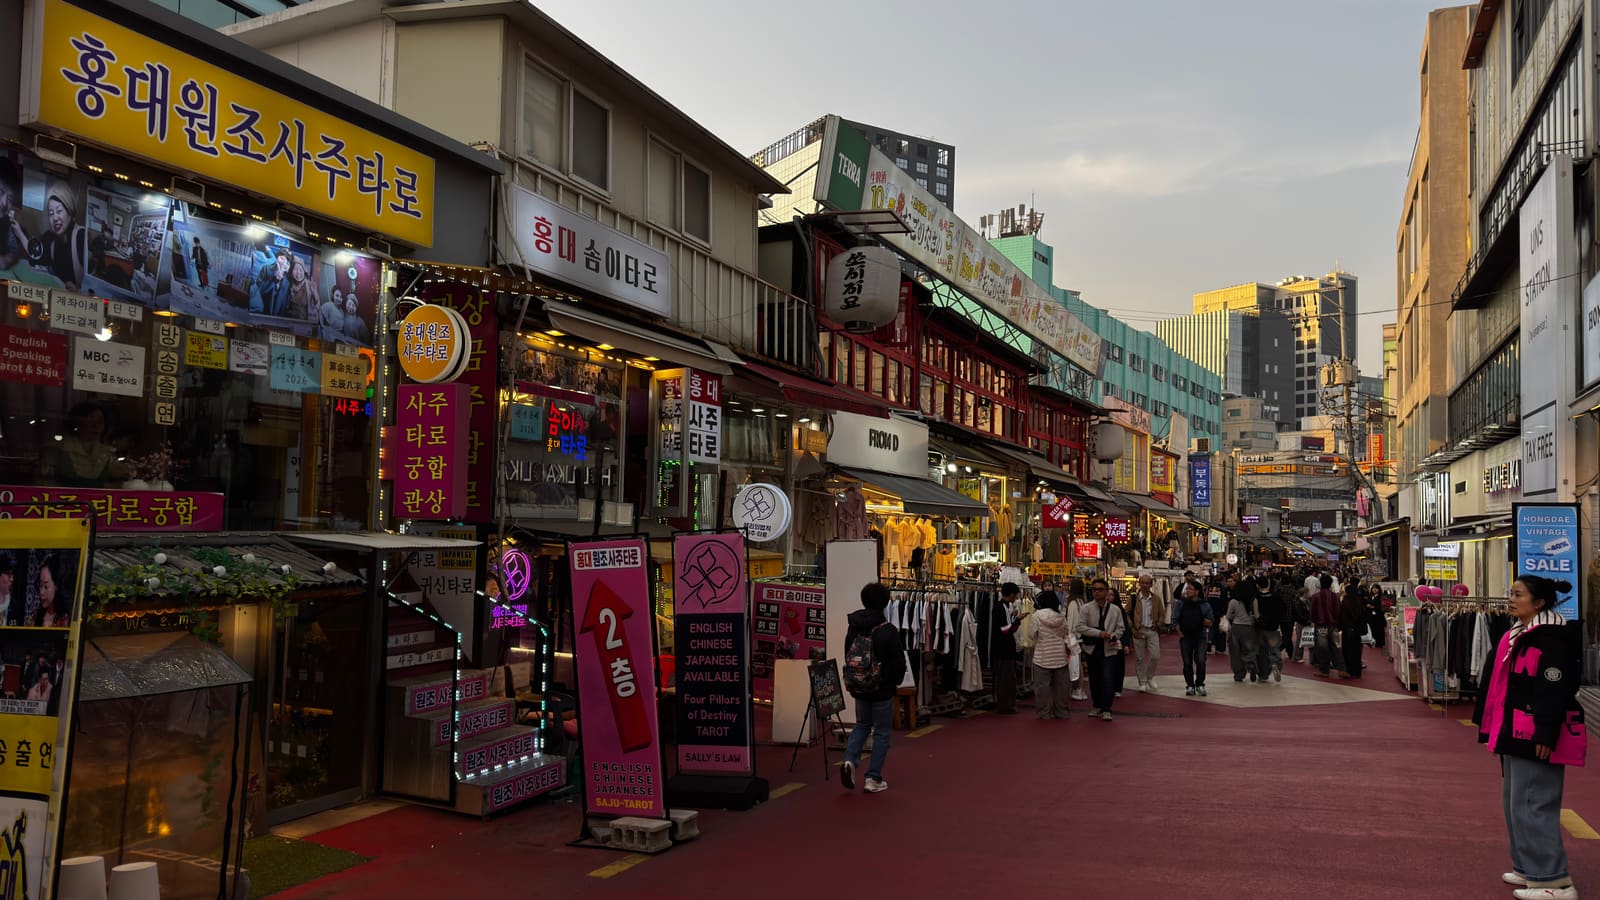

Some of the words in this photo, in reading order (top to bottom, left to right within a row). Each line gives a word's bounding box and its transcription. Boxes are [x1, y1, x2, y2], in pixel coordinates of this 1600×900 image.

[62, 33, 422, 219] 홍대원조사주타로
[838, 151, 861, 188] TERRA
[533, 215, 576, 264] 홍대
[1529, 219, 1544, 256] UNS
[1525, 258, 1551, 307] STATION
[56, 295, 98, 312] 계좌이체
[55, 312, 98, 329] 카드결제
[402, 322, 450, 343] 홍대원조
[9, 334, 48, 349] English
[2, 347, 52, 365] Speaking
[83, 349, 110, 363] MBC
[402, 343, 449, 362] 사주타로
[0, 362, 23, 374] arot
[36, 366, 59, 379] Saju
[405, 391, 449, 417] 사주
[689, 404, 718, 431] 사주
[405, 423, 448, 449] 타로
[869, 428, 891, 451] FROM
[892, 434, 899, 451] D
[689, 432, 718, 458] 타로
[1525, 438, 1537, 464] TAX
[1537, 431, 1553, 460] FREE
[403, 455, 448, 480] 궁합
[1195, 469, 1207, 500] 부동산
[402, 488, 447, 514] 관상
[1523, 515, 1571, 524] HONGDAE
[1526, 528, 1569, 536] VINTAGE
[1525, 557, 1572, 572] SALE
[420, 575, 474, 596] 귀신타로
[689, 622, 733, 633] ENGLISH
[689, 639, 733, 649] CHINESE
[684, 655, 738, 665] JAPANESE
[684, 672, 740, 682] AVAILABLE
[683, 694, 706, 704] Four
[709, 694, 741, 705] Pillars
[687, 711, 698, 720] of
[700, 711, 737, 723] Destiny
[696, 726, 730, 737] TAROT
[685, 752, 721, 763] SALLY'S
[722, 755, 741, 764] LAW
[593, 762, 652, 773] ENGLISH
[593, 774, 653, 785] CHINESE
[595, 785, 653, 796] JAPANESE
[595, 797, 654, 810] SAJU-TAROT
